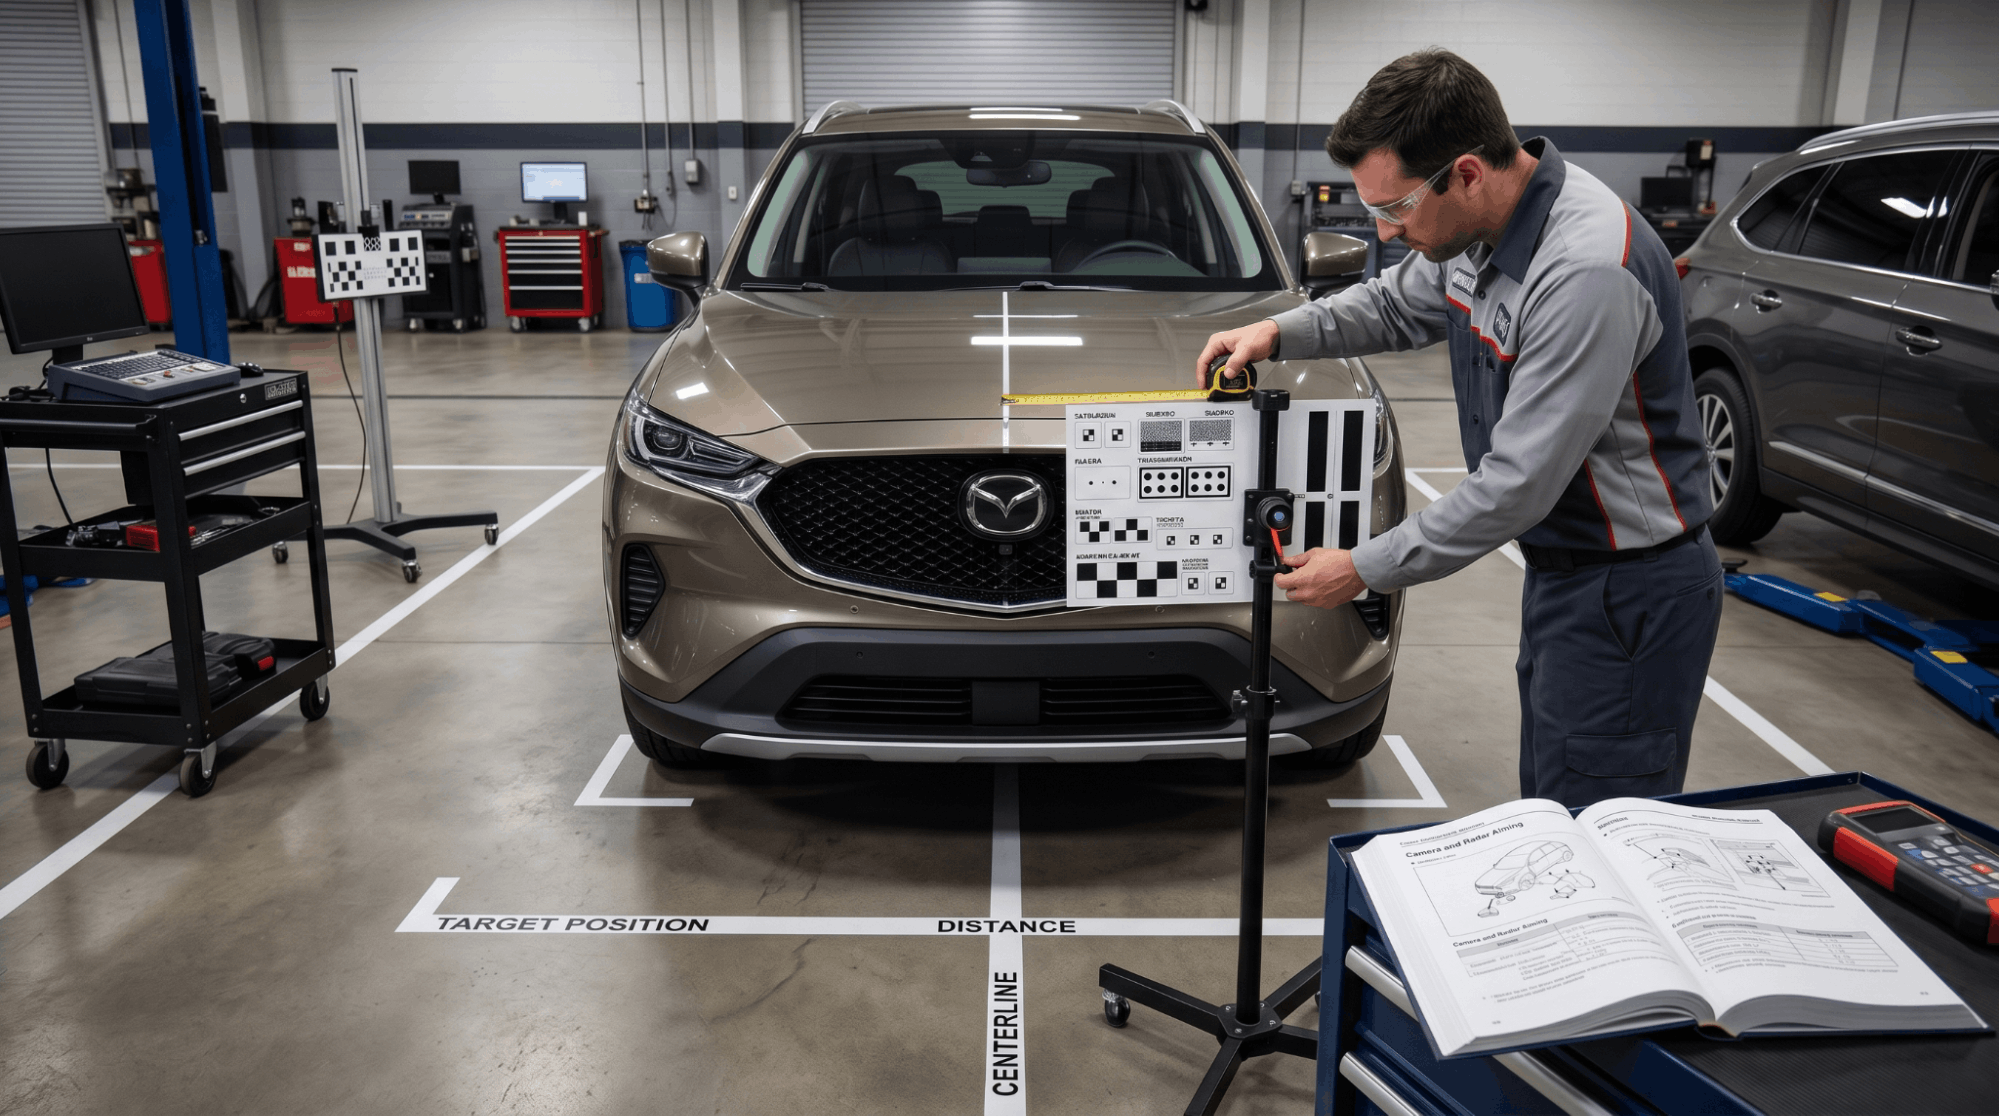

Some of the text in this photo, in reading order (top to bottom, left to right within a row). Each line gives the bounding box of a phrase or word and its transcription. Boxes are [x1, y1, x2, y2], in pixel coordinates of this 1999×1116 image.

[1405, 846, 1442, 858] Camera
[1444, 841, 1461, 851] and
[1463, 832, 1490, 845] Radar
[1492, 821, 1524, 836] Aiming
[437, 917, 710, 932] TARGET POSITION
[937, 920, 1077, 933] DISTANCE
[992, 971, 1019, 1096] CENTERLINE
